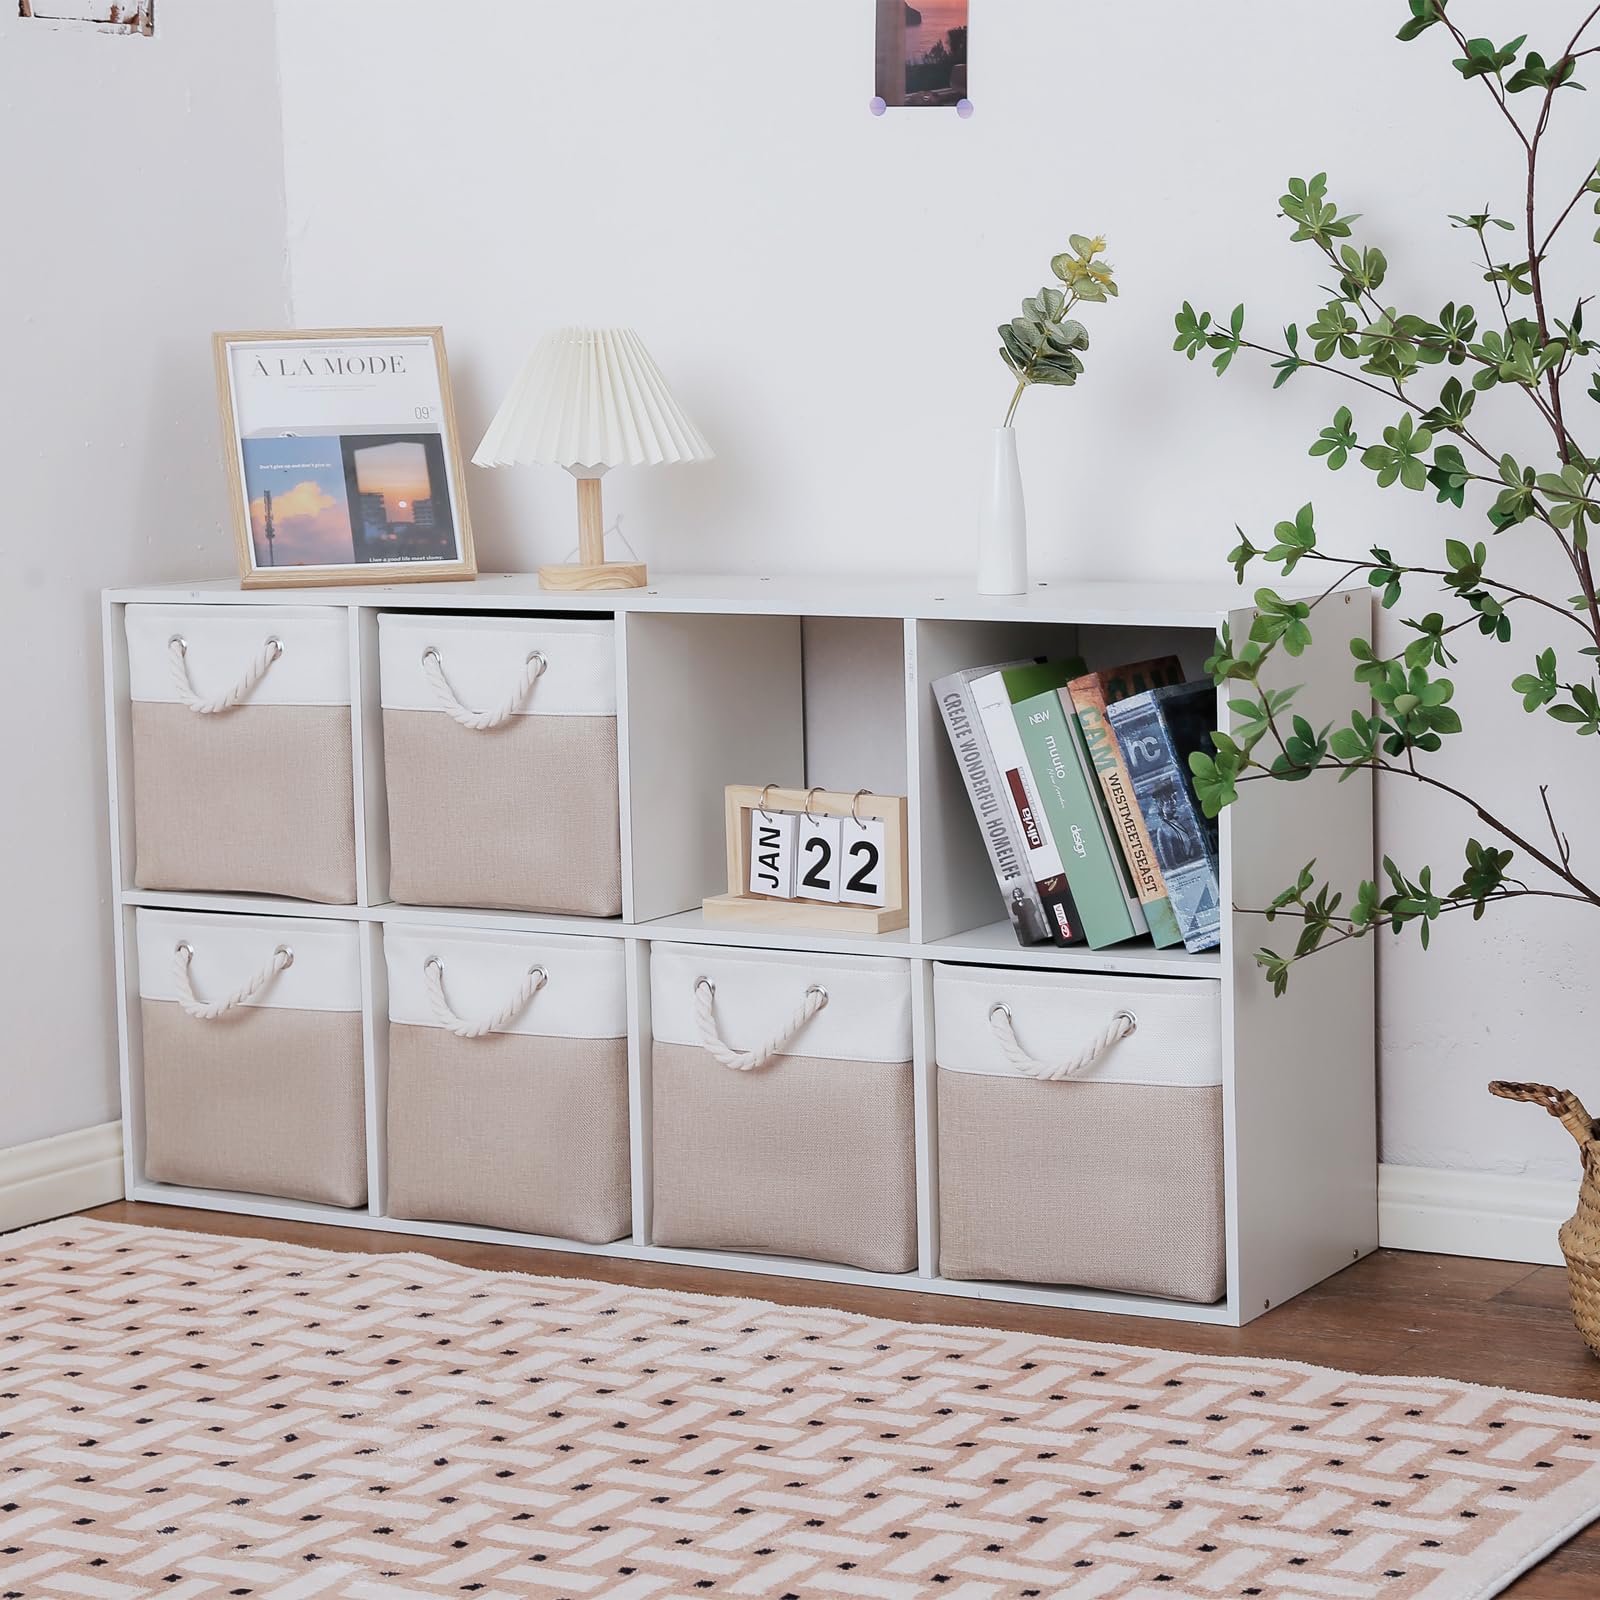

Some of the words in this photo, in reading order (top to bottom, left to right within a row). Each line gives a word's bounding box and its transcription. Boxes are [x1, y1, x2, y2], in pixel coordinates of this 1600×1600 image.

[275, 356, 315, 376] LA
[321, 355, 407, 375] MODE
[1028, 709, 1051, 726] NEW
[1045, 735, 1066, 779] muuto
[1079, 706, 1118, 774] CAM
[943, 693, 973, 739] CREATE
[960, 738, 999, 817] WONDERFUL
[985, 817, 1022, 881] HOMELIFE
[1021, 807, 1041, 845] olivia
[1070, 824, 1087, 859] design
[758, 826, 781, 889] JAN
